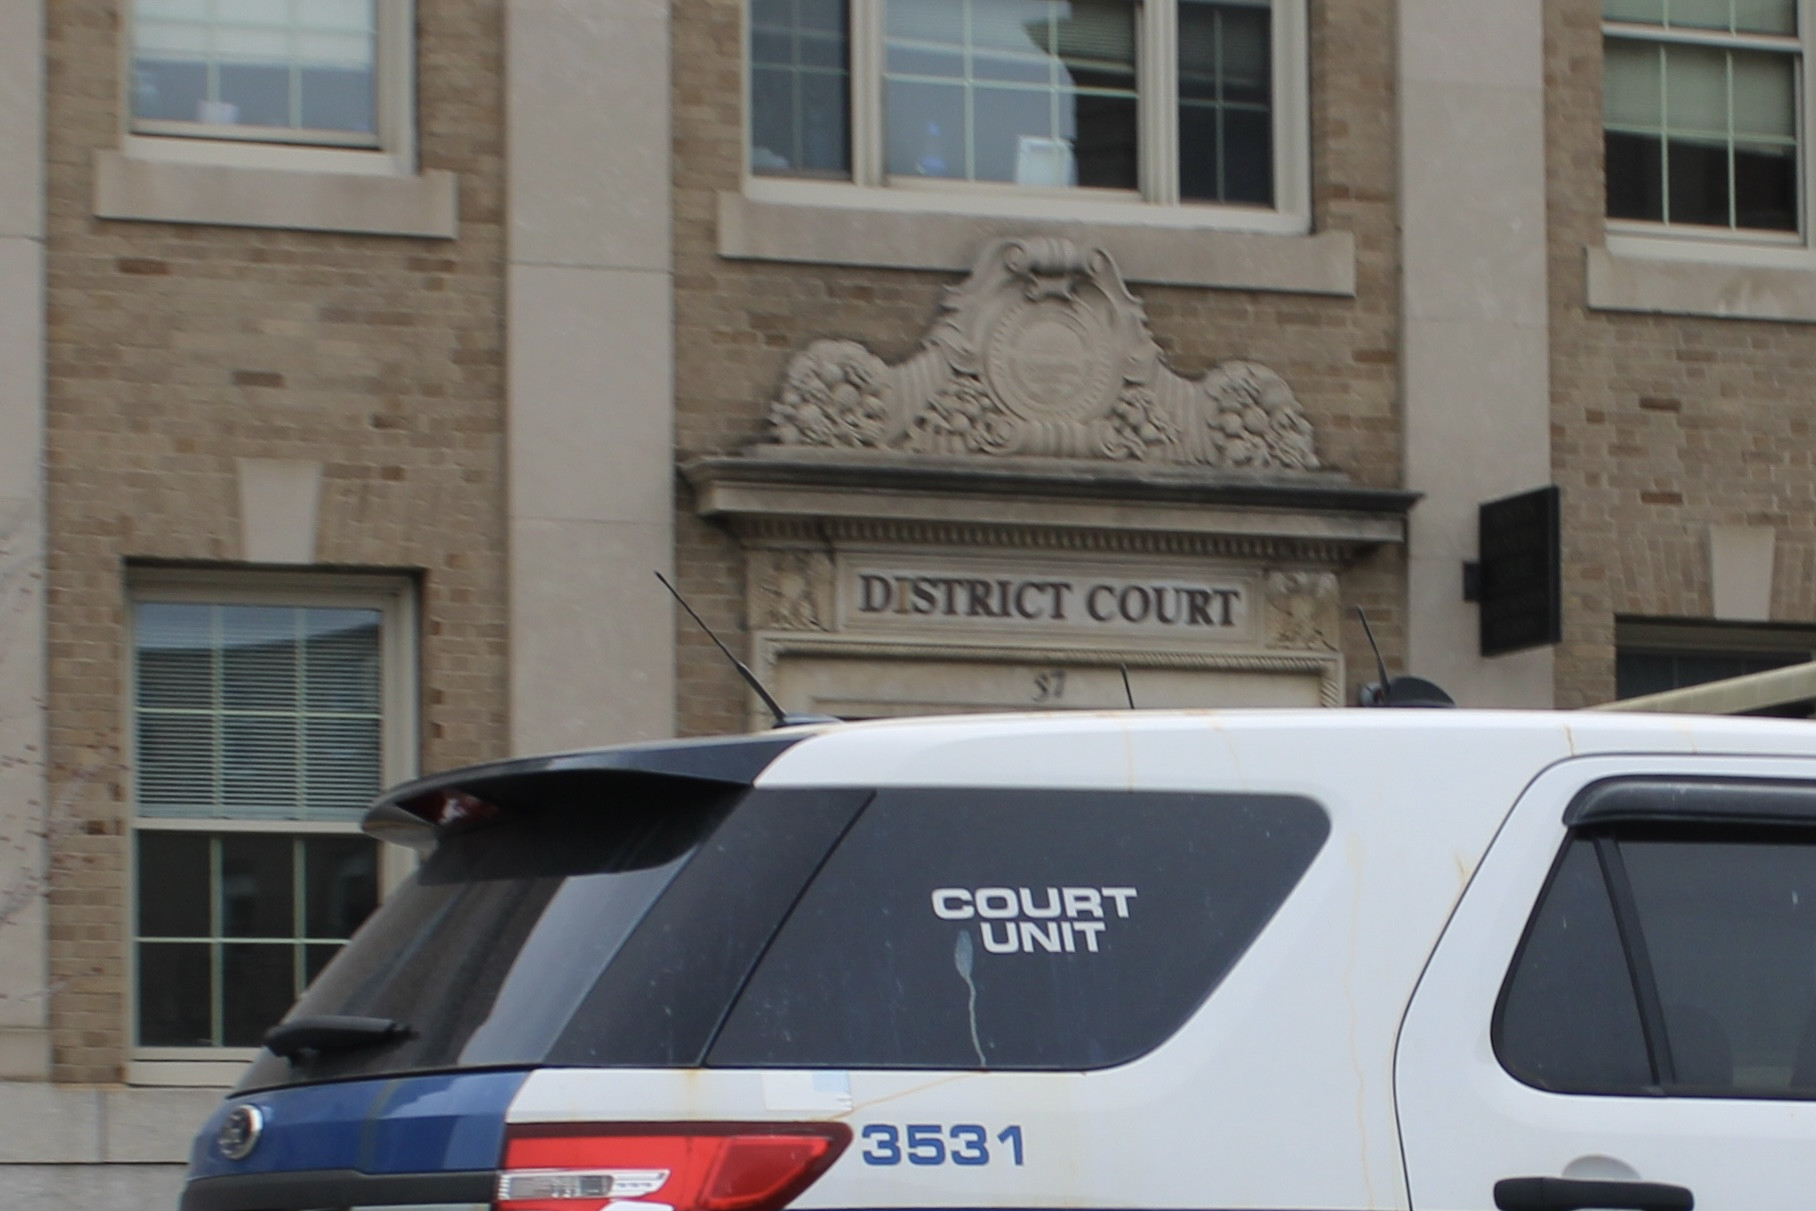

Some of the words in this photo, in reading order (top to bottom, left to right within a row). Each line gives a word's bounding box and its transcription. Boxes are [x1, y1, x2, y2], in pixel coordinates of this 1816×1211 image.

[860, 574, 1071, 620] DISTRICT
[1087, 585, 1241, 627] COURT
[931, 887, 1138, 919] COURT
[980, 920, 1106, 954] UNIT
[862, 1123, 1025, 1166] 3531
